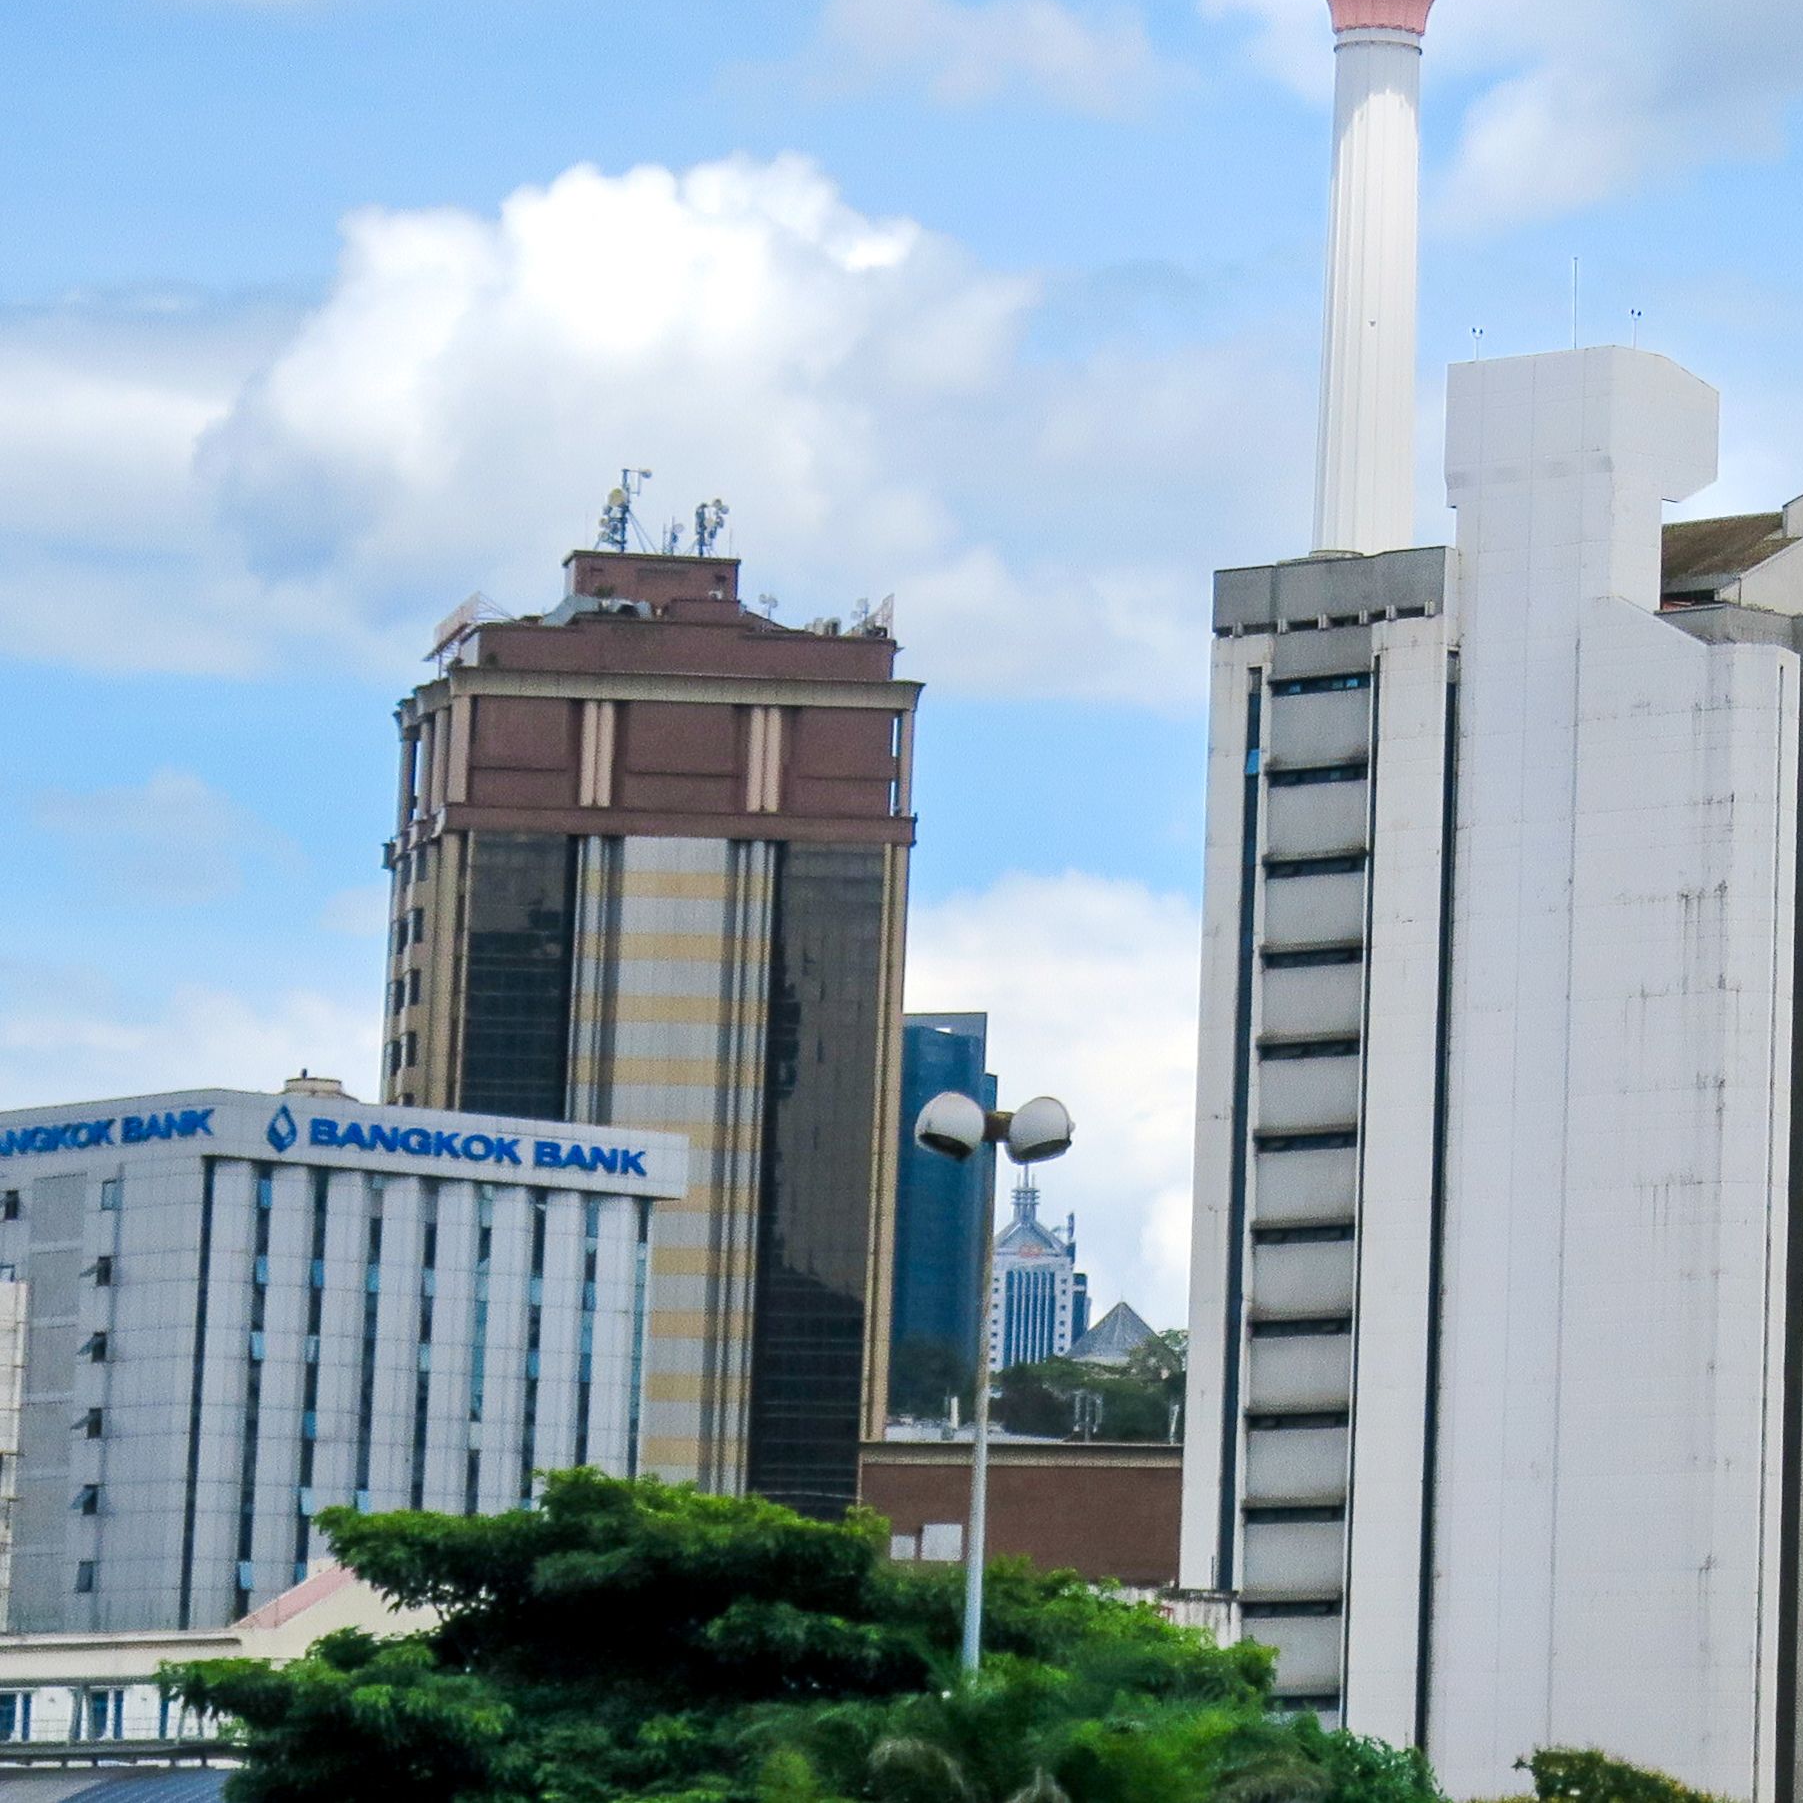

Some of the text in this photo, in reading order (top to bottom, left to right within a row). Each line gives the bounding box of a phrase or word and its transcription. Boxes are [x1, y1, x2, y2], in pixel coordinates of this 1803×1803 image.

[120, 1108, 215, 1144] BANK
[310, 1117, 648, 1176] BANGKOK BANK
